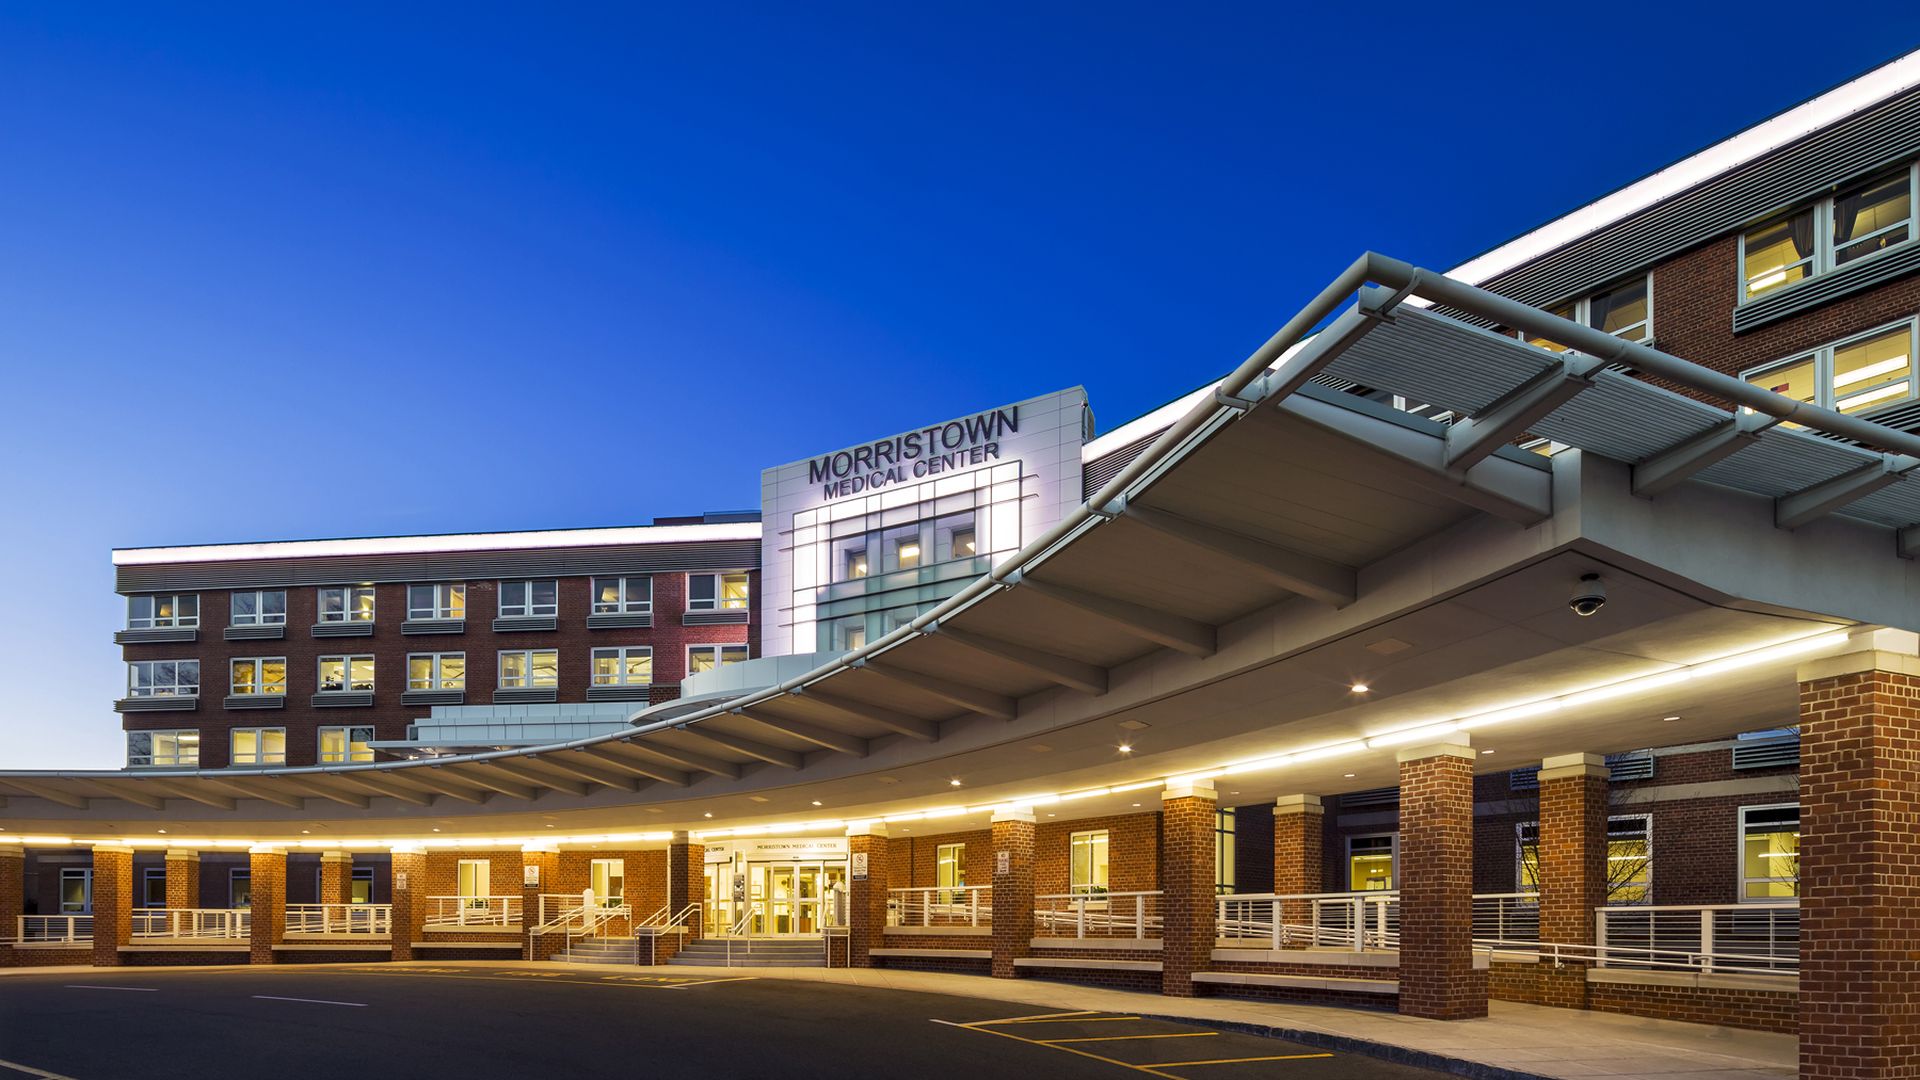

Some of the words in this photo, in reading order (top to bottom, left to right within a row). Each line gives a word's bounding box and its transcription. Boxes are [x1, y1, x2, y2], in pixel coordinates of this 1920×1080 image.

[809, 405, 1019, 484] MORRISTOWN
[823, 469, 908, 501] MEDICAL
[913, 442, 1000, 479] CENTER
